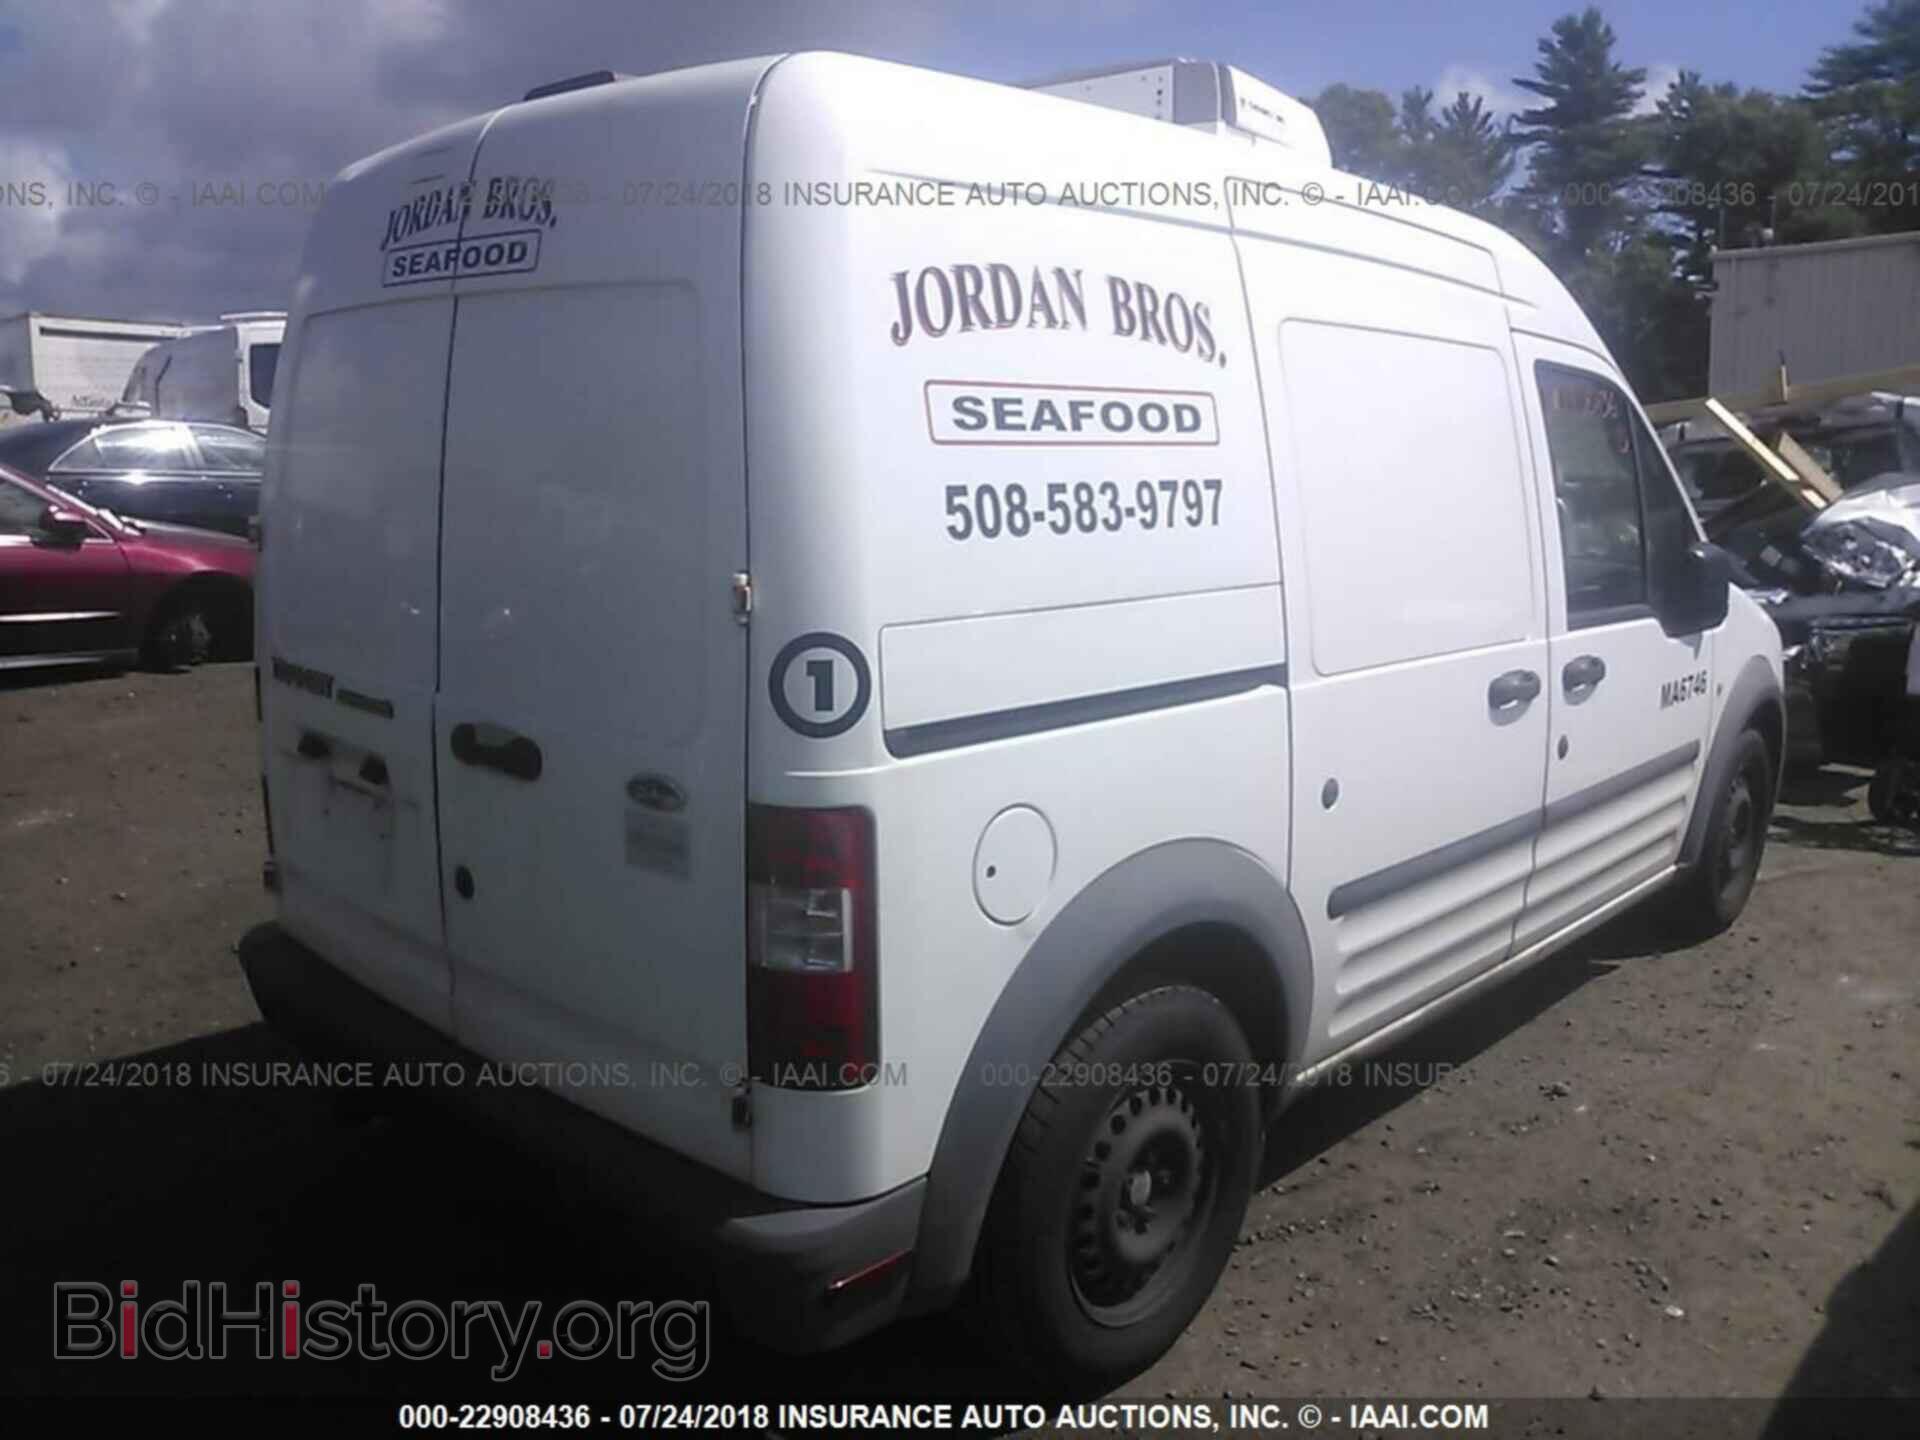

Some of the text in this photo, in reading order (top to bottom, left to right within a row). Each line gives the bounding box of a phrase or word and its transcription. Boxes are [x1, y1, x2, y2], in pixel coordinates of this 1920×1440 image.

[391, 240, 529, 278] SEAFOOD
[891, 263, 1228, 368] JORDAN BROS.
[951, 395, 1202, 434] SEAFOOD
[945, 479, 1224, 540] 508-583-9797
